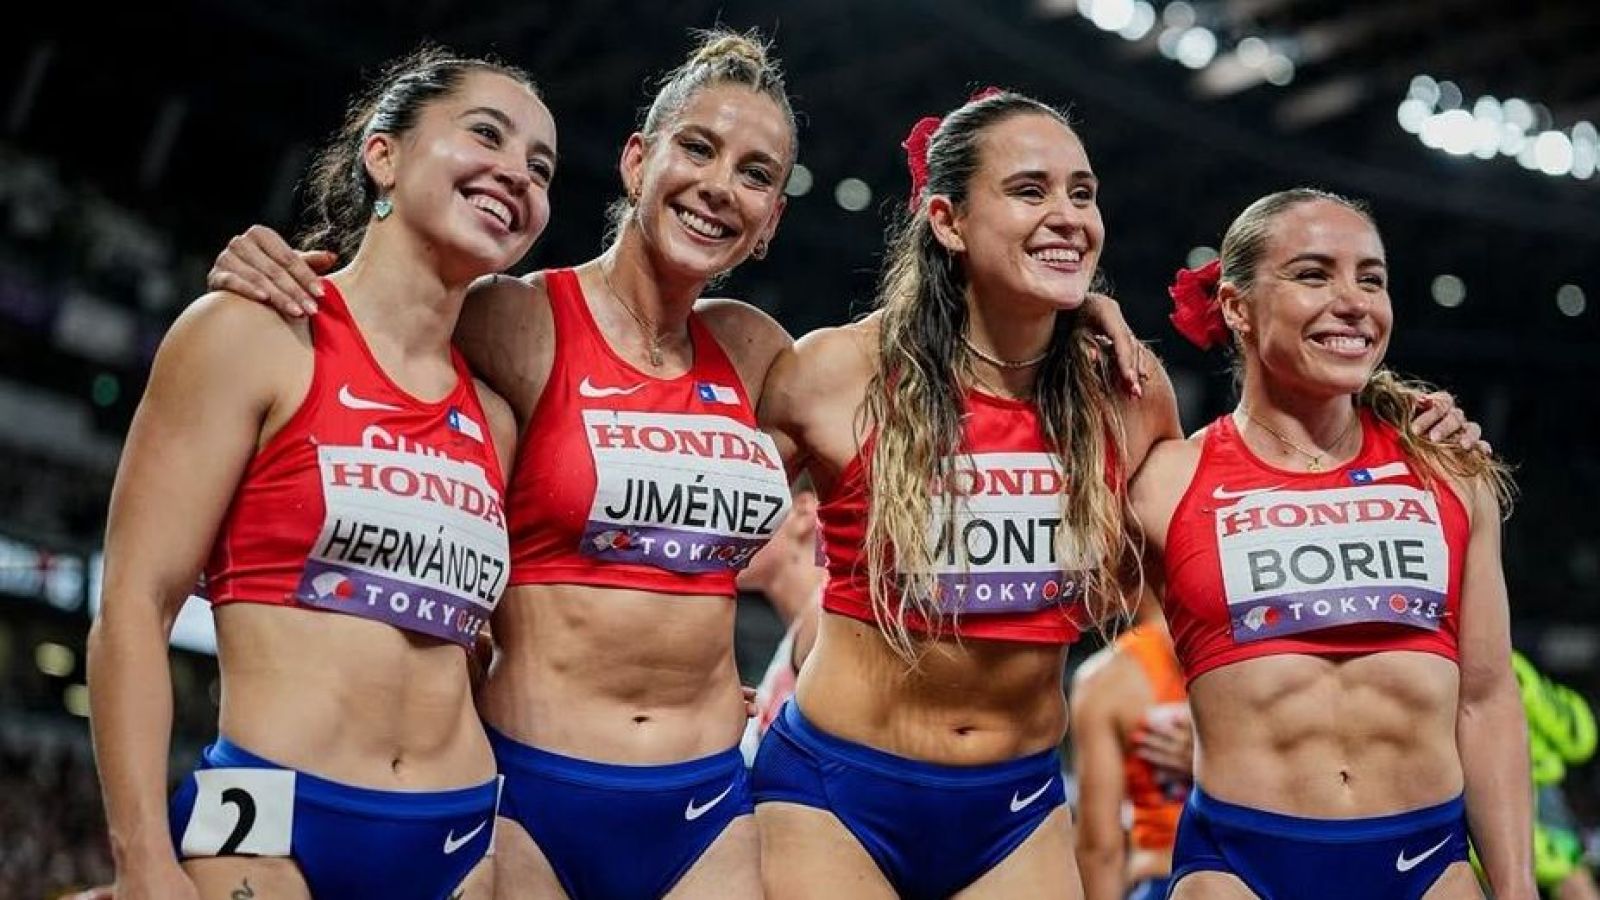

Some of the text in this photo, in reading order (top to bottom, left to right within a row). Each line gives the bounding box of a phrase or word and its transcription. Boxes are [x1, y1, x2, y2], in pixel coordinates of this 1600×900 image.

[592, 424, 777, 470] HONDA
[330, 462, 505, 530] HONDA
[605, 475, 783, 534] JIMÉNEZ
[1222, 498, 1437, 537] HONDA
[321, 519, 505, 604] HERNÁNDEZ
[1247, 540, 1428, 592] BORIE
[216, 787, 260, 857] 2
